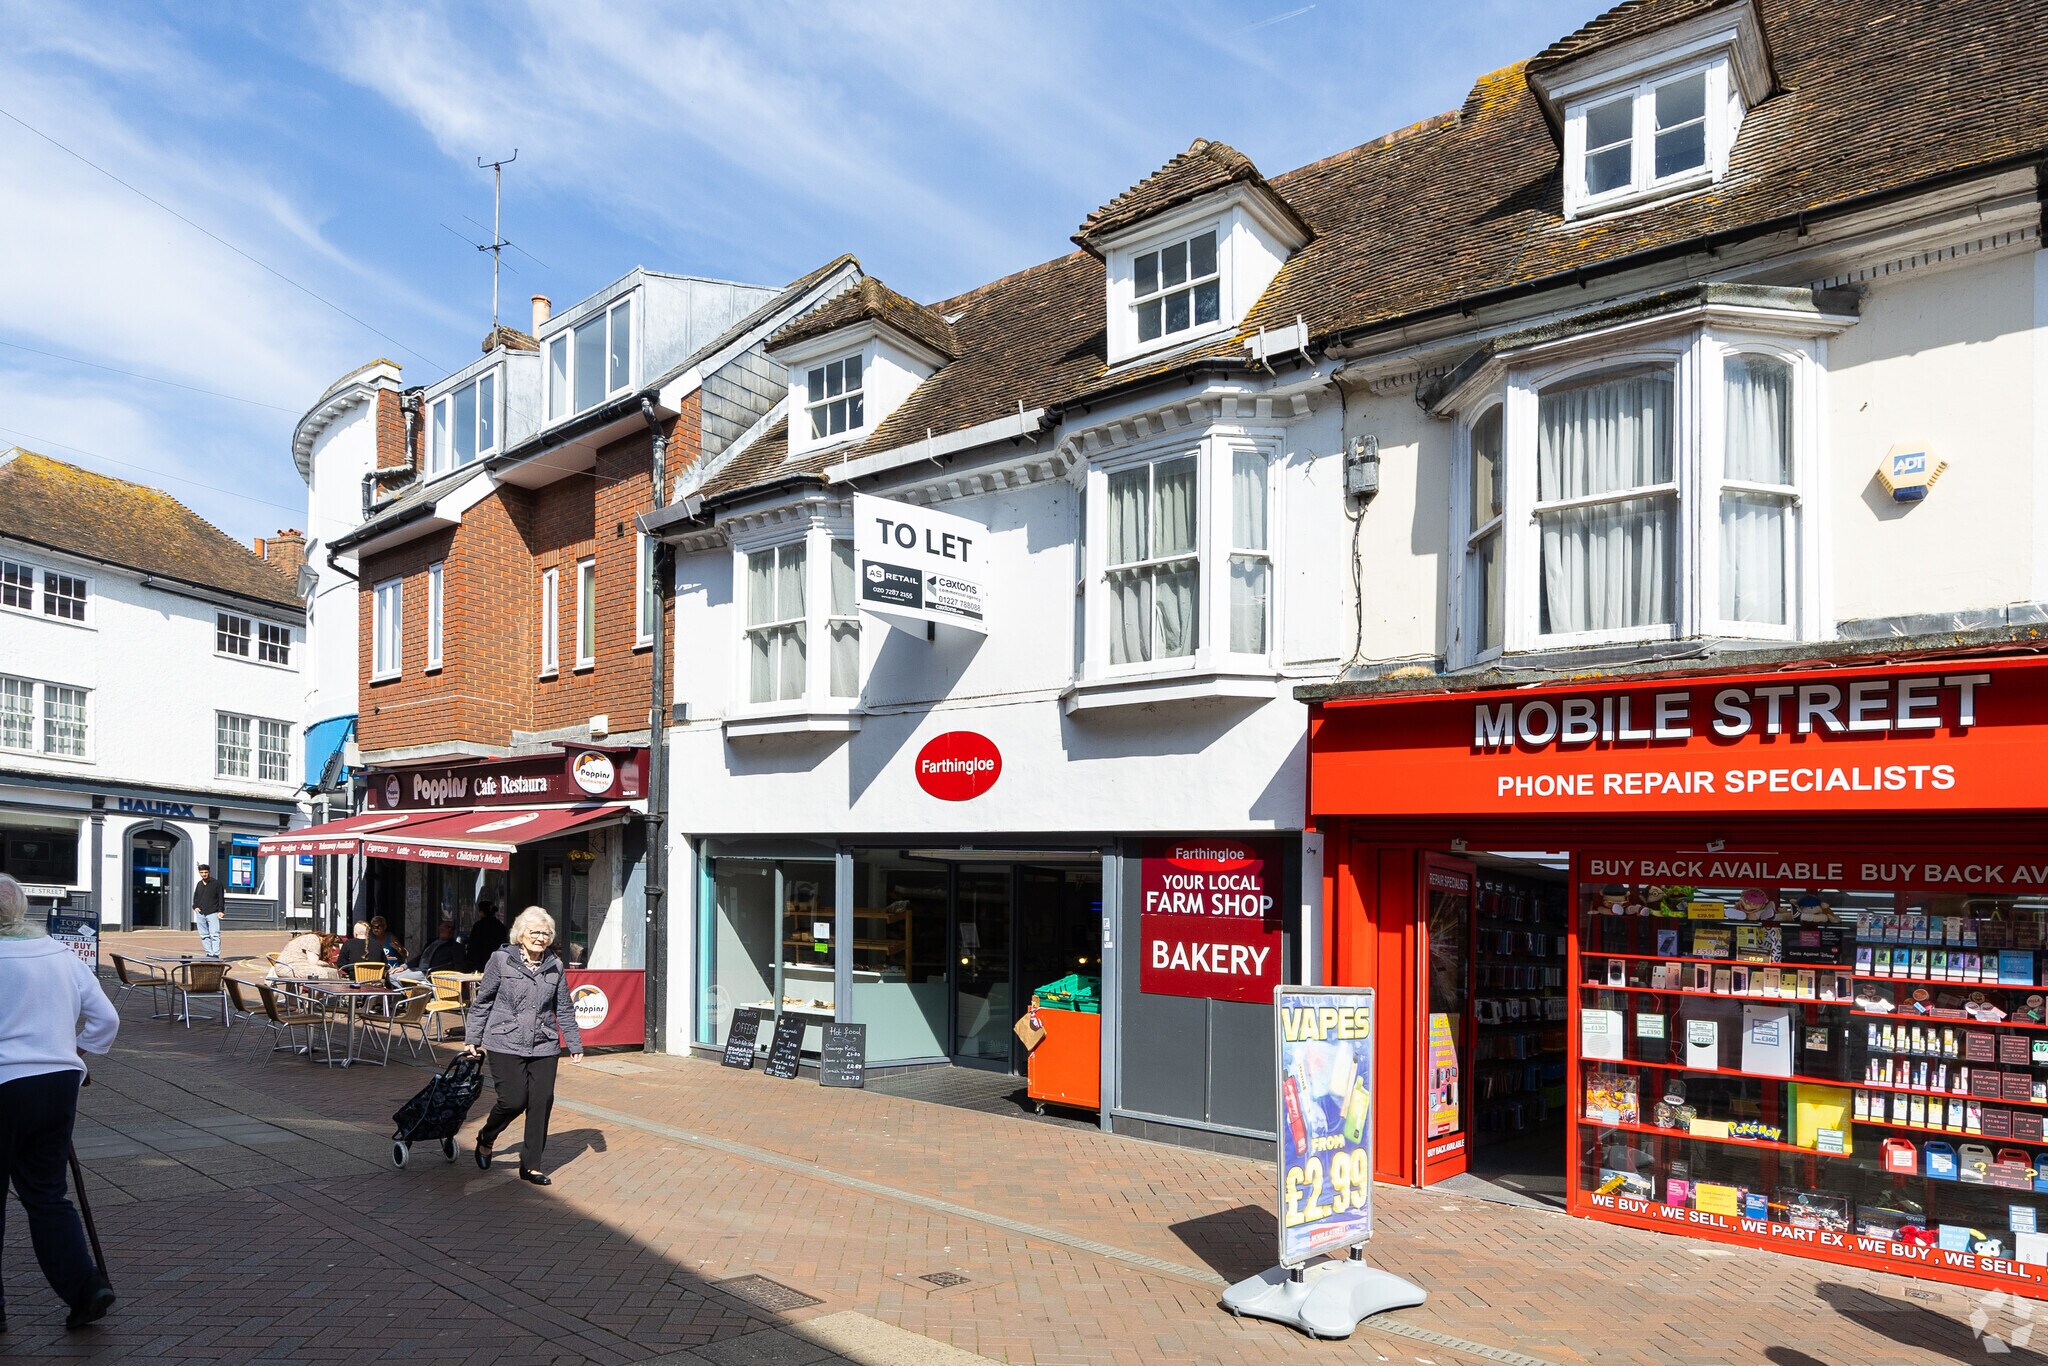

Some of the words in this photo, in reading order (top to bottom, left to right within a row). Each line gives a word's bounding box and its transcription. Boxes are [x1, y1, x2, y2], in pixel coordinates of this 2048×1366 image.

[1894, 457, 1925, 475] ADT
[876, 517, 917, 549] TO
[926, 528, 972, 562] LET
[869, 569, 882, 578] AS
[886, 572, 918, 585] RETAIL
[939, 578, 977, 595] caxtons
[872, 586, 885, 594] 020
[938, 595, 958, 606] 01227
[1474, 692, 1694, 748] MOBILE
[1711, 673, 1992, 738] STREET
[580, 768, 610, 779] Poppins
[921, 757, 994, 775] Farthingloe
[413, 770, 468, 806] Poppins
[474, 776, 496, 797] Cafe
[501, 776, 548, 795] Restaura
[1497, 773, 1595, 797] PHONE
[1603, 771, 1716, 795] REPAIR
[1724, 764, 1956, 793] SPECIALISTS
[119, 797, 195, 817] HALIFAX
[367, 844, 388, 853] Espresso
[397, 846, 410, 855] Latte
[419, 848, 449, 859] Cappuccino
[457, 851, 483, 862] Children's
[484, 855, 503, 864] Meals
[1175, 847, 1245, 863] Farthingloe
[1429, 872, 1445, 887] REPAIR
[1445, 875, 1469, 891] SPECIALISTS
[1590, 860, 1635, 876] BUY
[1640, 861, 1704, 878] BACK
[1709, 861, 1843, 881] AVAILABLE
[1861, 863, 1917, 882] BUY
[1924, 864, 2005, 884] BACK
[1162, 874, 1205, 890] YOUR
[1208, 874, 1261, 891] LOCAL
[1146, 891, 1204, 914] FARM
[1211, 893, 1274, 917] SHOP
[1152, 940, 1271, 976] BAKERY
[735, 1022, 758, 1035] OFFERS
[830, 1026, 842, 1036] Hot
[844, 1027, 862, 1037] food
[1281, 1006, 1371, 1042] VAPES
[1311, 1134, 1346, 1153] FROM
[1427, 1148, 1436, 1157] BUY
[1436, 1144, 1447, 1155] BACK
[1447, 1139, 1465, 1151] AVAILABLE
[1285, 1148, 1369, 1228] £2.99
[1591, 1193, 1614, 1208] WE
[1618, 1198, 1649, 1214] BUY
[1660, 1205, 1685, 1221] WE
[1689, 1210, 1729, 1228] SELL
[1741, 1220, 1767, 1235] WE
[1771, 1224, 1817, 1243] PART
[1820, 1231, 1844, 1247] EX
[1857, 1237, 1886, 1254] WE
[1891, 1243, 1930, 1261] BUY
[1944, 1251, 1975, 1269] WE
[1980, 1258, 2031, 1279] SELL
